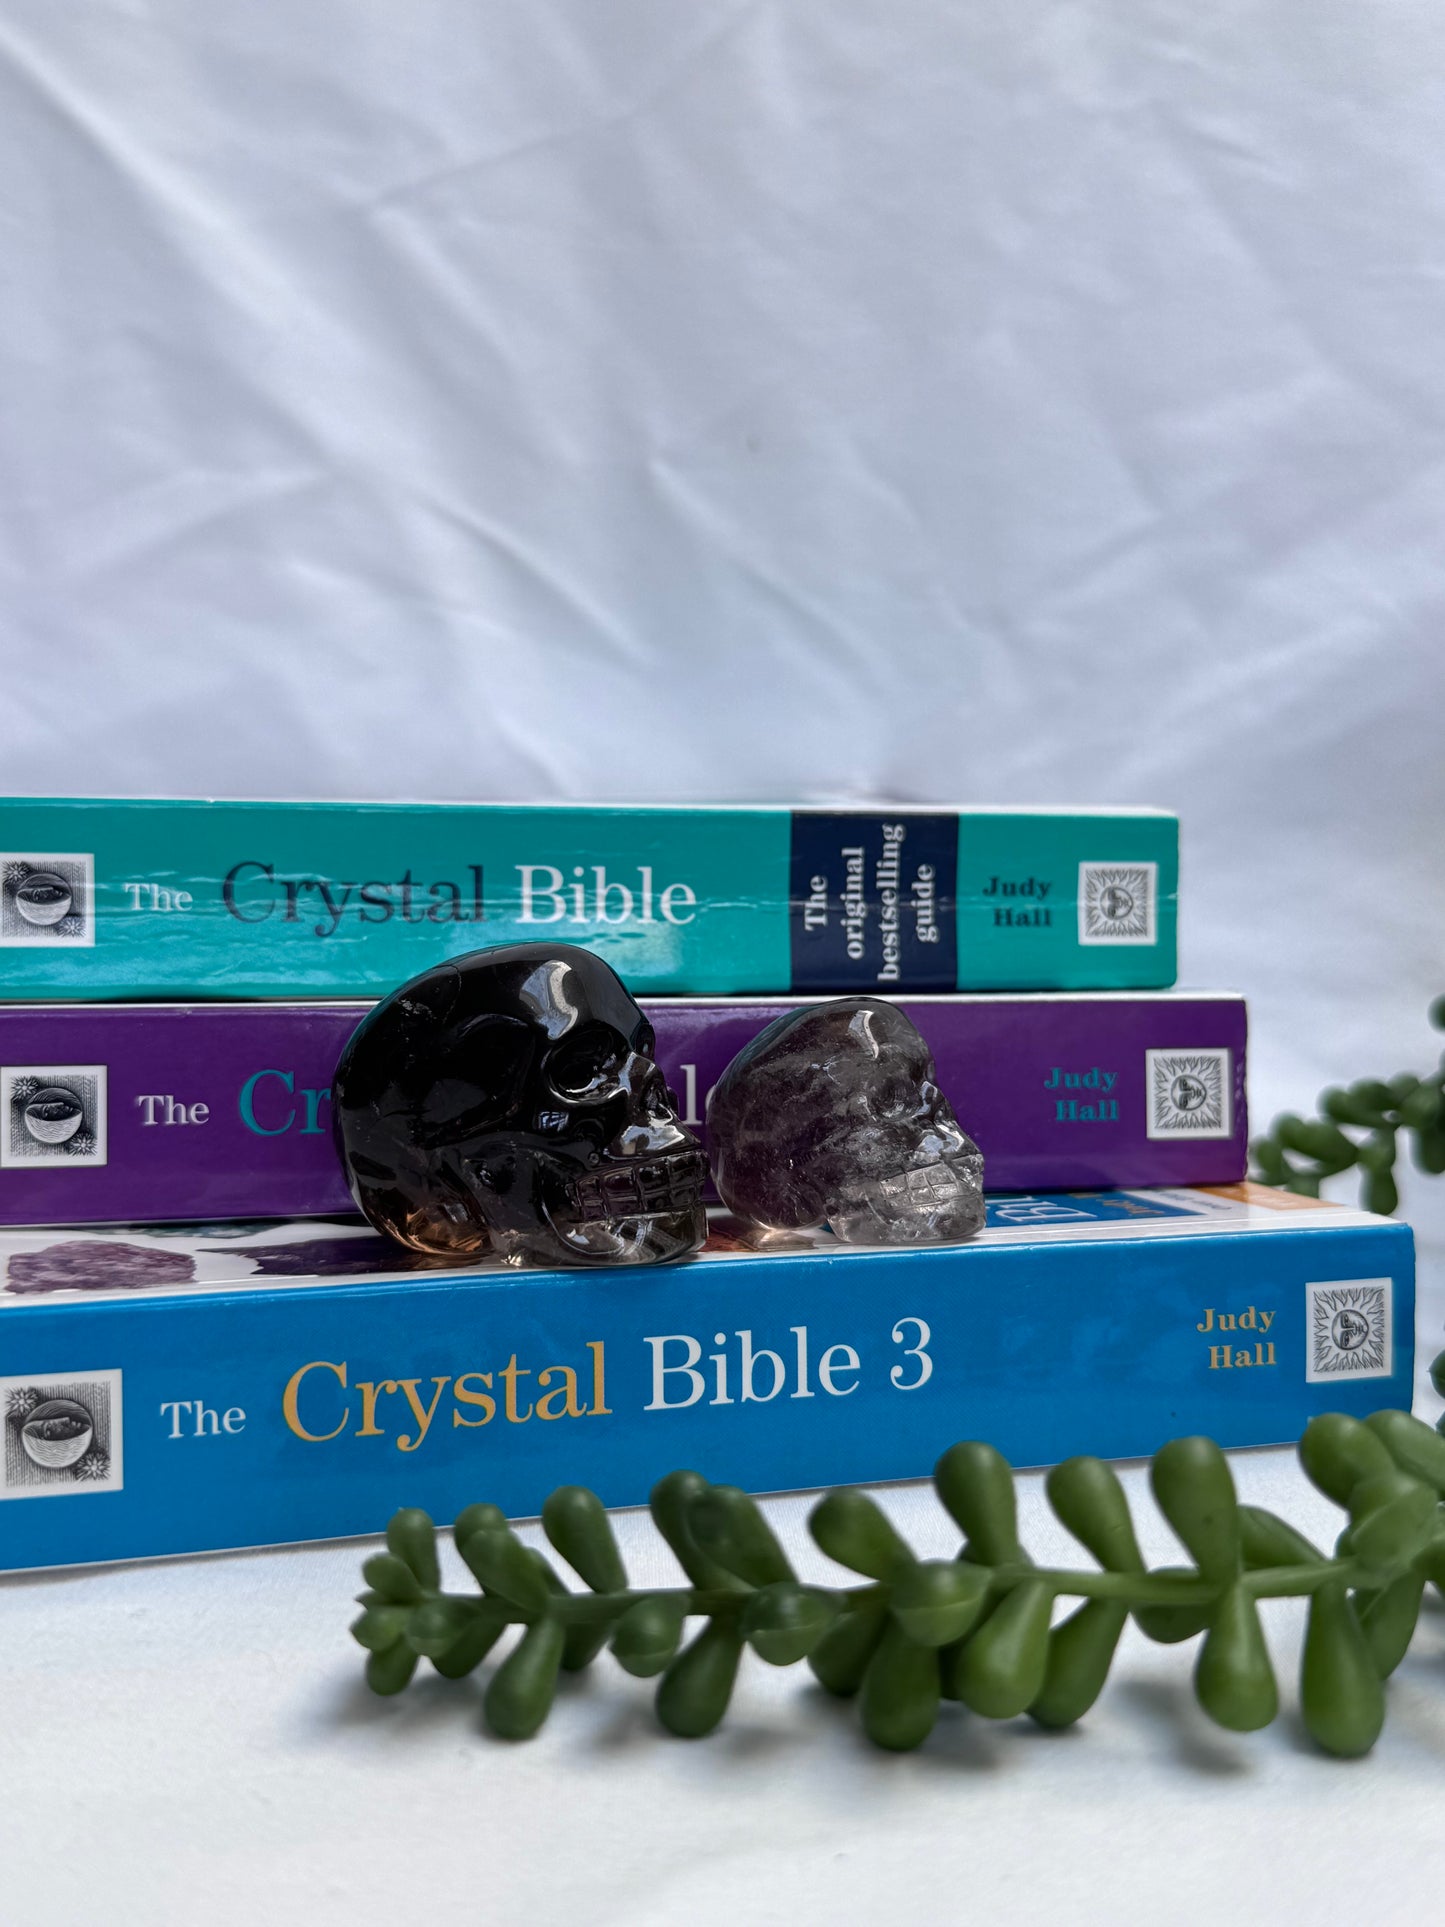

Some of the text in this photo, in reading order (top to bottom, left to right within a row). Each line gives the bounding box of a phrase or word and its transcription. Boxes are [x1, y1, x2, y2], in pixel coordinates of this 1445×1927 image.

[124, 861, 697, 937] The Crystal Bible
[804, 874, 828, 931] The
[841, 847, 865, 960] original
[877, 824, 905, 982] bestselling
[911, 863, 938, 943] guide
[982, 877, 1052, 900] Judy
[993, 908, 1052, 927] Hall
[137, 1068, 332, 1136] The Cr
[1043, 1066, 1118, 1092] Judy
[1055, 1099, 1119, 1121] Hall
[1197, 1306, 1277, 1333] Judy
[1208, 1341, 1277, 1370] Hall
[160, 1317, 934, 1453] The Crystal Bible 3
